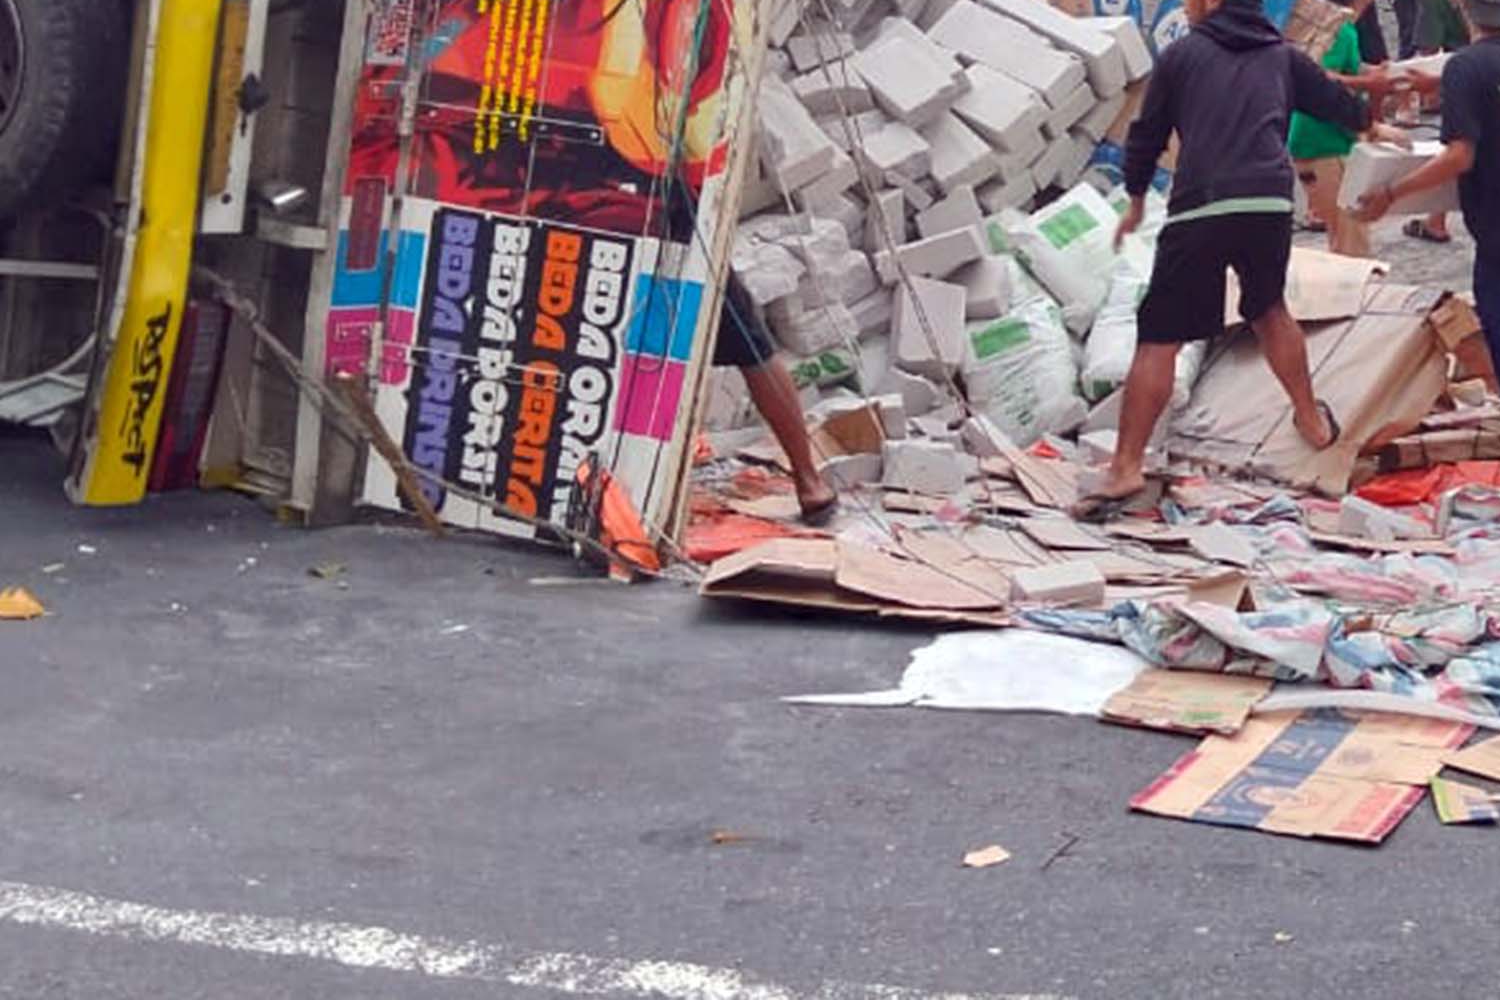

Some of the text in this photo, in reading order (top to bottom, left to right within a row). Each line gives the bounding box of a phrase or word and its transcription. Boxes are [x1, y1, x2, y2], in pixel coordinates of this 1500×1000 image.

[411, 213, 479, 511] BEDA PRINSP
[459, 222, 532, 485] BEDA PORSI
[504, 228, 583, 517] BEDA CERITA
[576, 238, 629, 361] BEDA
